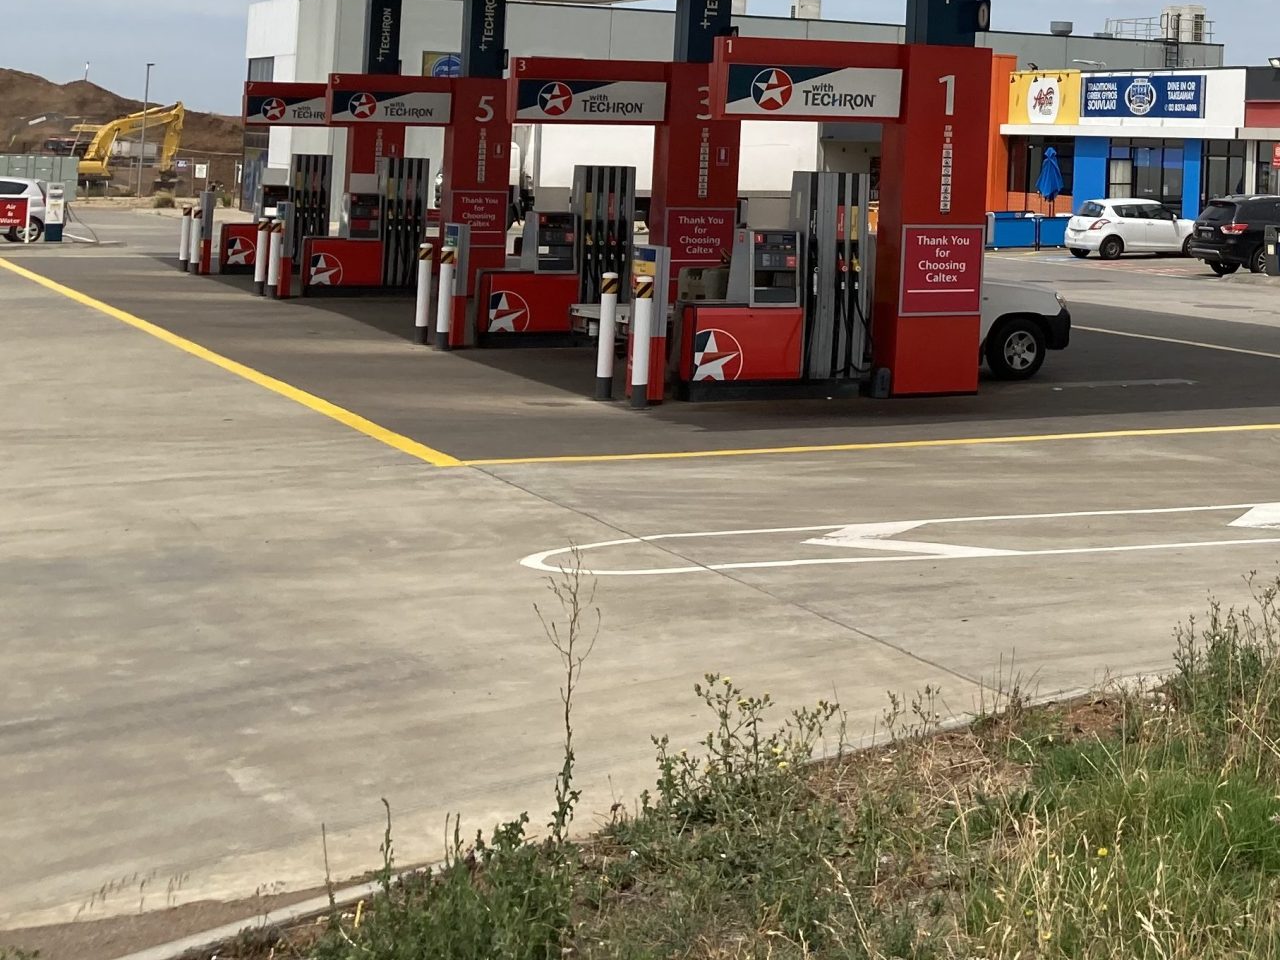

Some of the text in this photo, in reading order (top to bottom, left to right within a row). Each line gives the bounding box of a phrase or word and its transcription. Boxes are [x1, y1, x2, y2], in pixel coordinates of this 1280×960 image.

[726, 40, 733, 54] 1
[519, 60, 526, 71] 3
[334, 75, 341, 85] 5
[811, 82, 834, 93] with
[1087, 82, 1118, 91] TRADITIONAL
[1167, 81, 1196, 91] DINE IN OR
[803, 89, 876, 110] TECHRON
[939, 74, 956, 116] 1
[1101, 91, 1118, 100] GYROS
[1167, 91, 1195, 100] TAKEAWAY
[475, 95, 495, 122] 5
[581, 99, 644, 116] TECHRON
[696, 86, 713, 120] 3
[1087, 100, 1117, 110] SOUVLAKI
[384, 106, 434, 119] TECHRON
[461, 196, 498, 204] Thank You
[474, 204, 485, 212] for
[462, 212, 496, 221] Choosing
[678, 215, 724, 224] Thank You
[694, 225, 707, 234] for
[680, 235, 721, 247] Choosing
[916, 235, 970, 246] Thank You
[686, 245, 714, 254] Caltex
[935, 247, 951, 258] for
[918, 260, 966, 272] Choosing
[926, 272, 958, 283] Caltex
